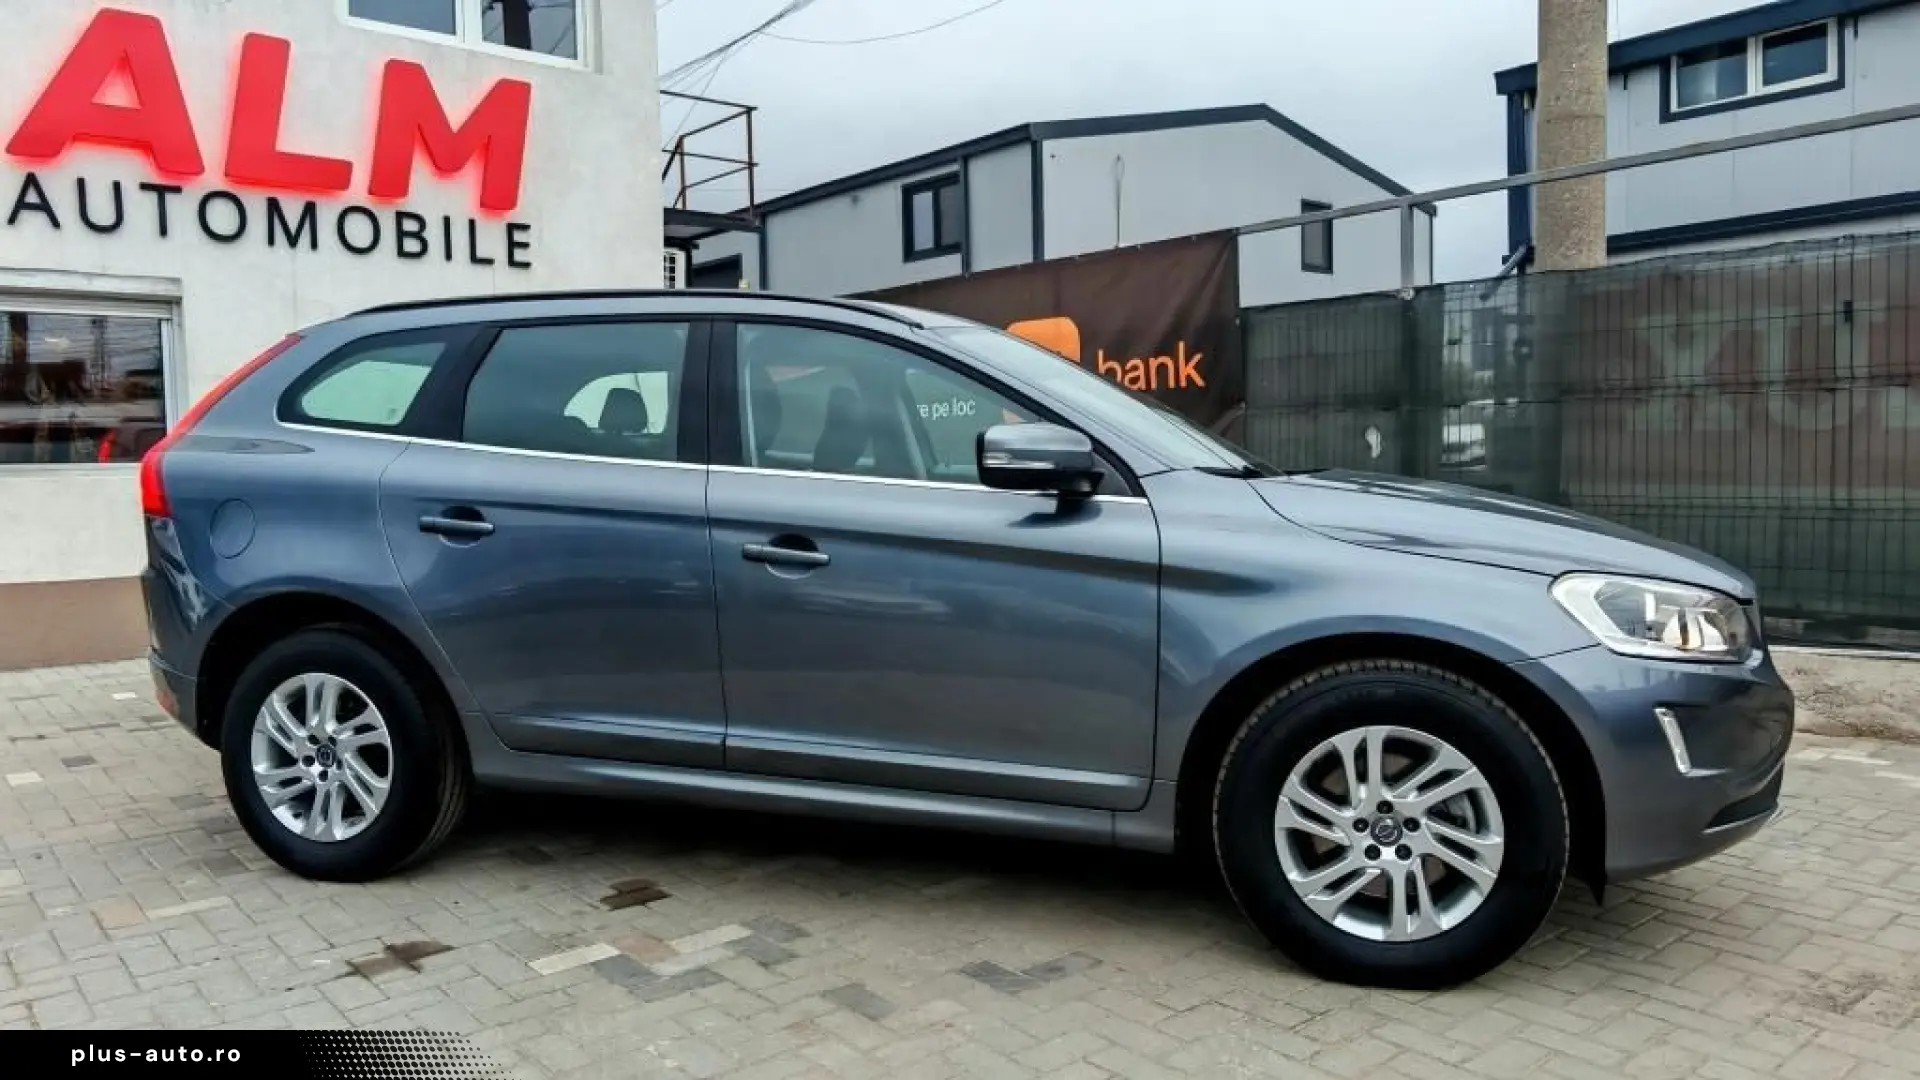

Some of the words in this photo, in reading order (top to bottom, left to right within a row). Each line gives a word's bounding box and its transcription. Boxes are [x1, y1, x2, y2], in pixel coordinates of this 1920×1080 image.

[5, 7, 532, 217] ALM
[7, 171, 532, 269] AUTOMOBILE
[932, 402, 949, 420] pe
[952, 397, 976, 416] loc
